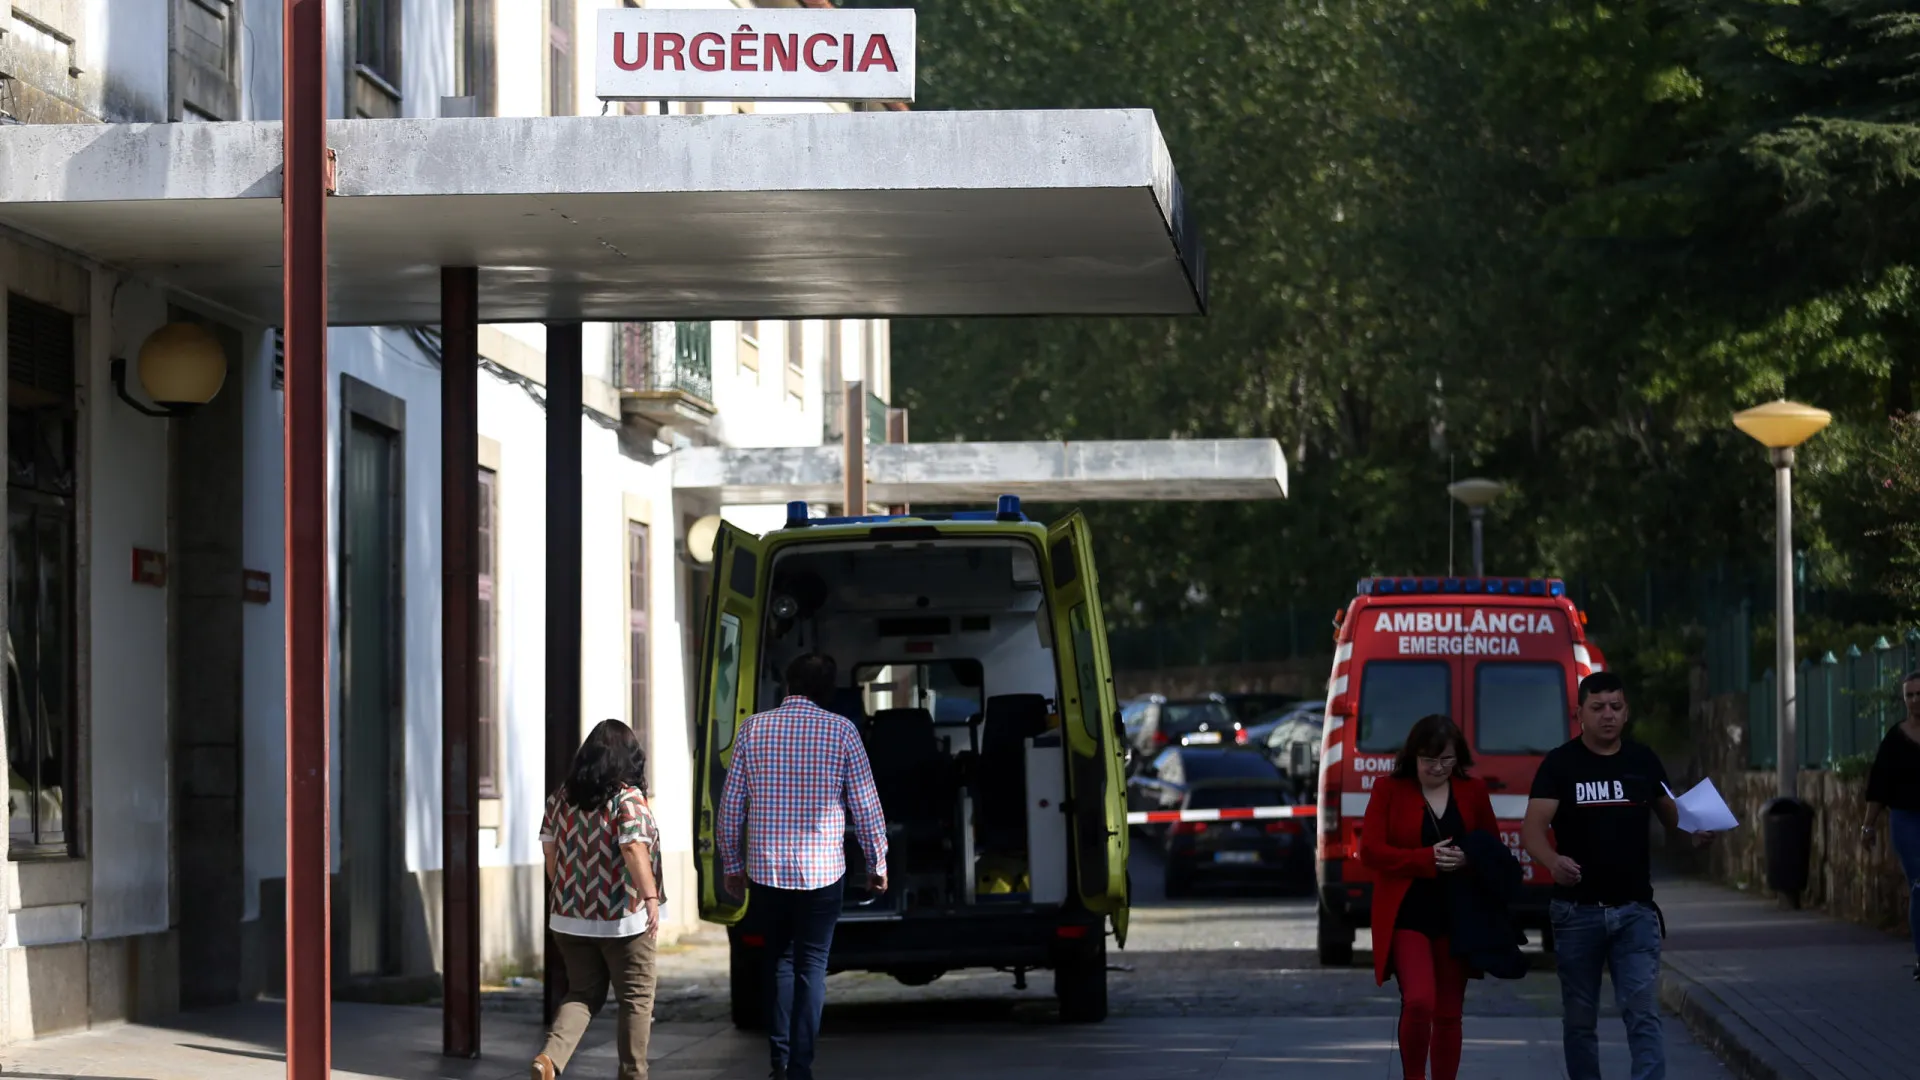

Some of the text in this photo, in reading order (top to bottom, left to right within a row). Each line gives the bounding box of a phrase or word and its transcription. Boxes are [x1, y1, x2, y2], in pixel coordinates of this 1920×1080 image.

[613, 24, 898, 72] URGÊNCIA
[1374, 609, 1555, 634] AMBULÂNCIA
[1398, 634, 1520, 656] EMERGÊNCIA
[1576, 780, 1624, 801] DNM B
